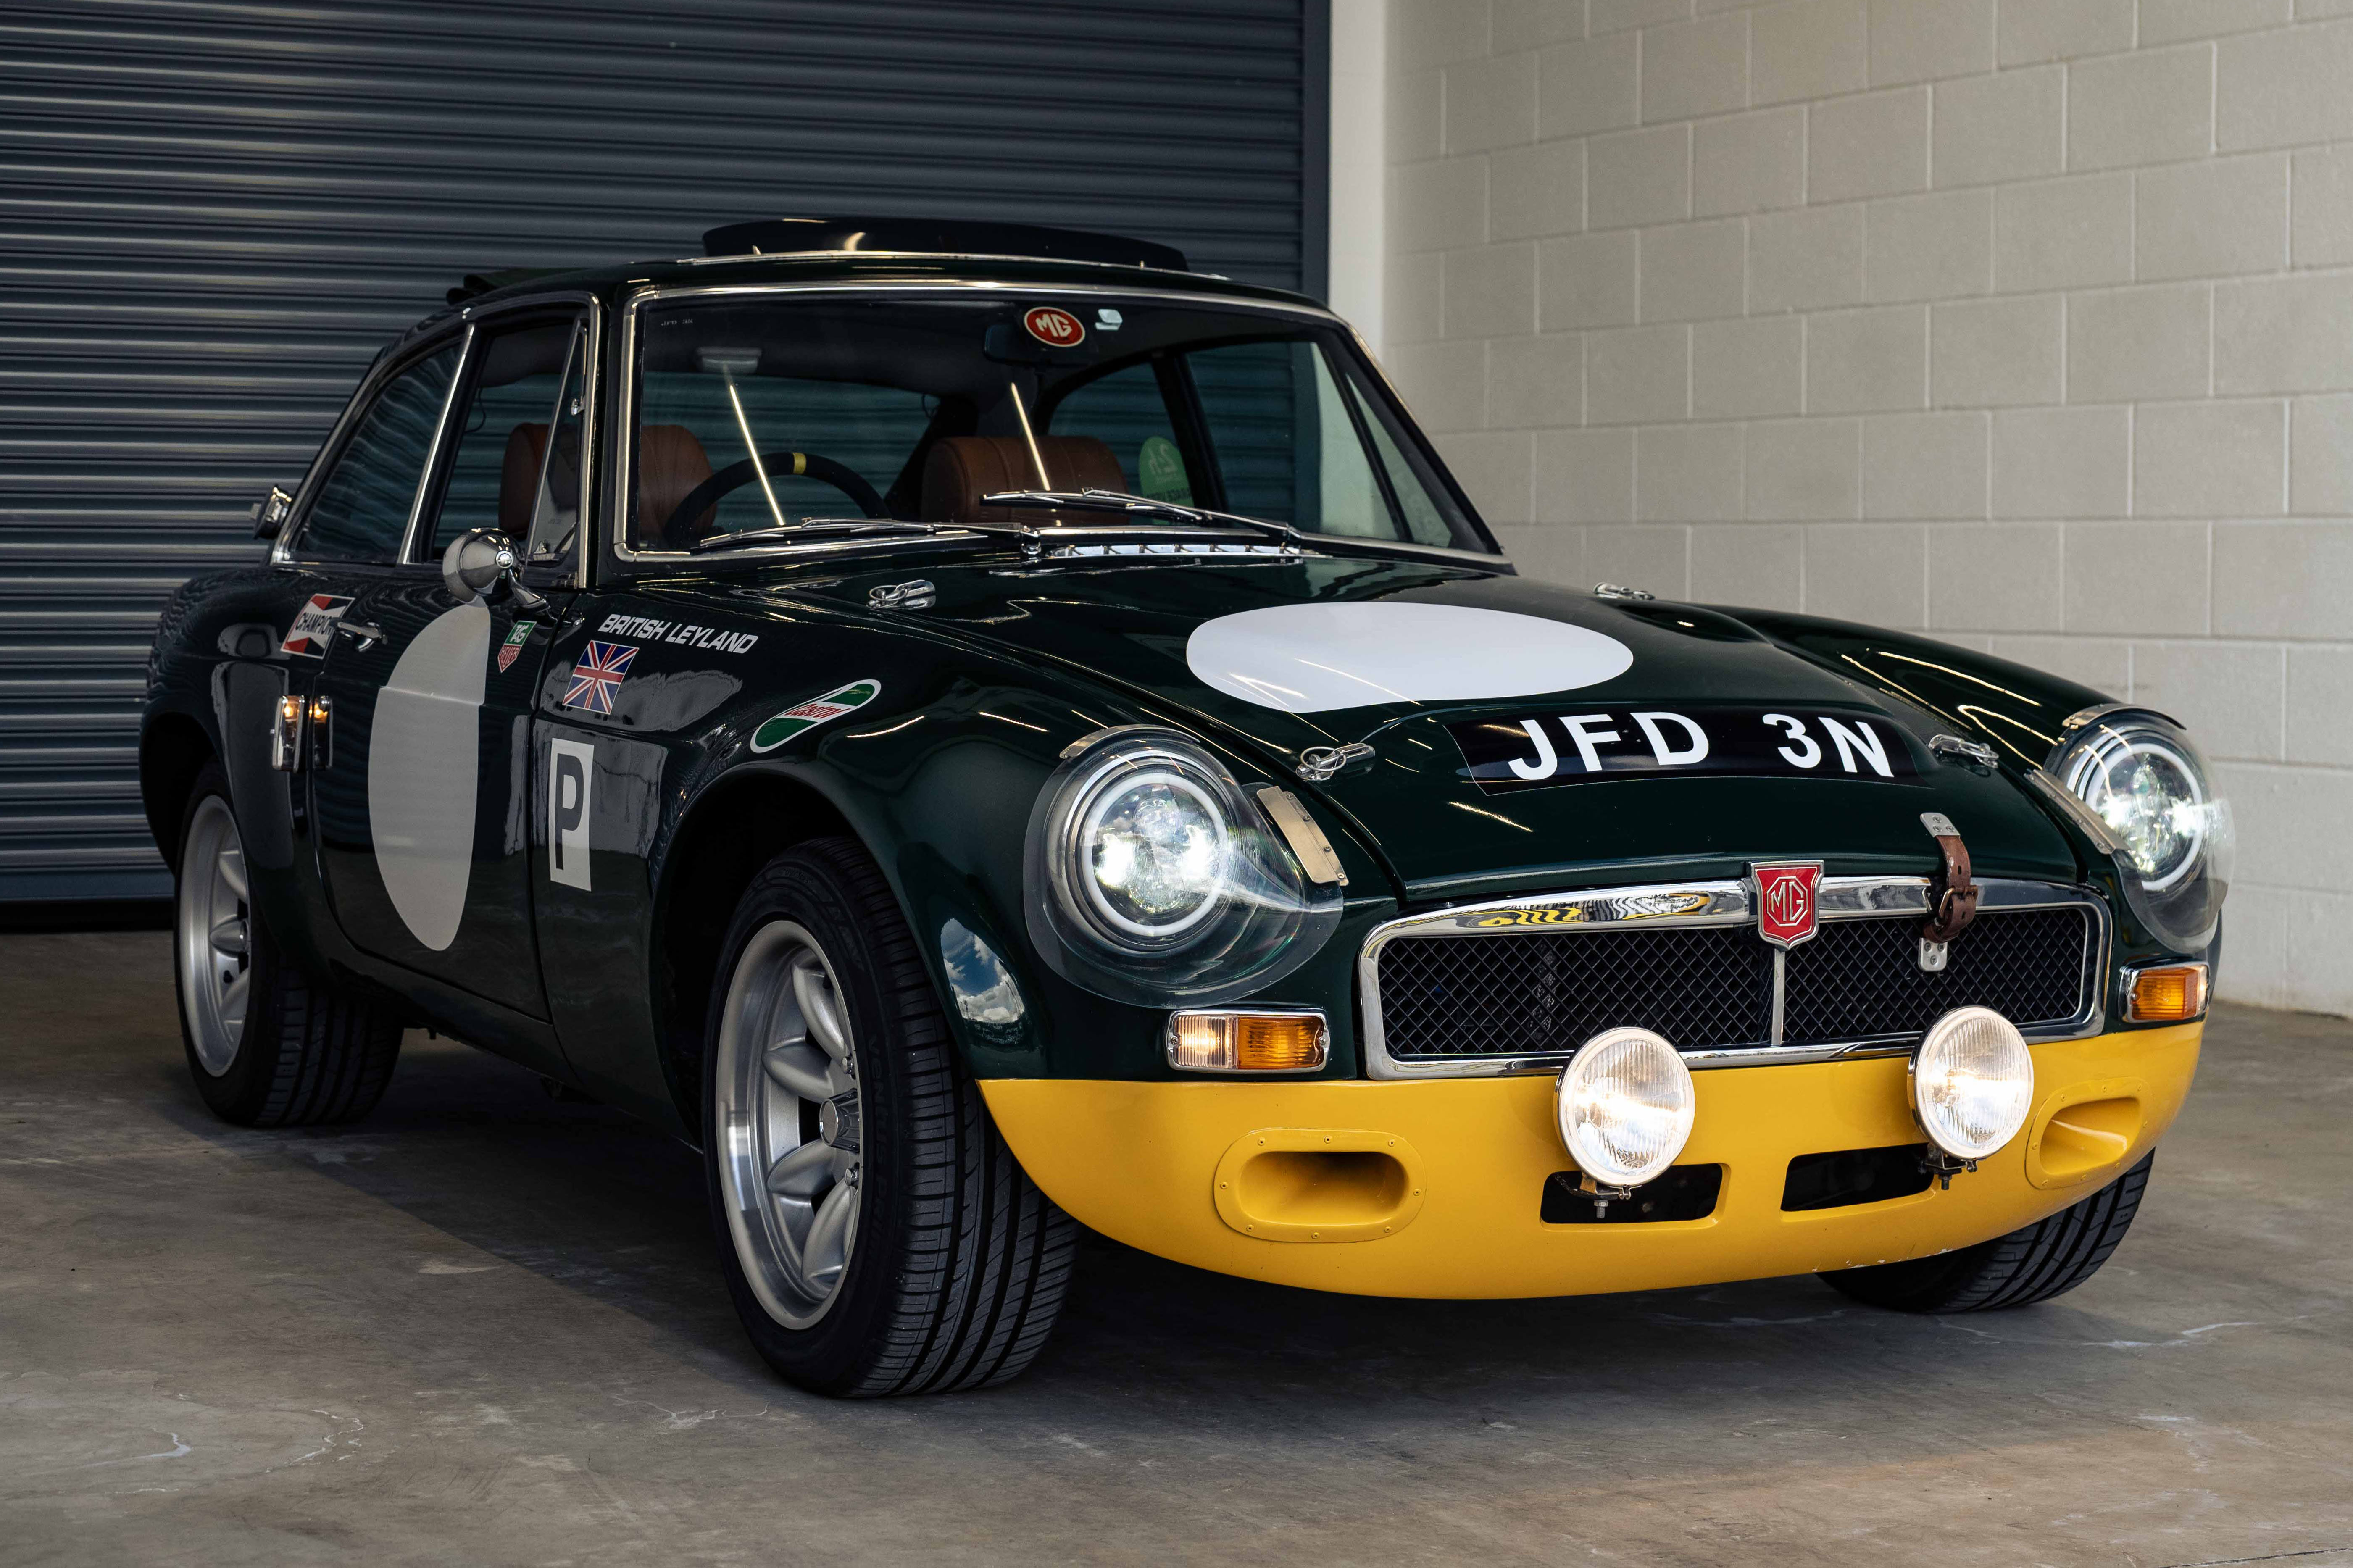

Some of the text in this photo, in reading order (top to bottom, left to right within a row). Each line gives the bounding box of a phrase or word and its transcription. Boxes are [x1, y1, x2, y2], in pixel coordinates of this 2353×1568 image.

[1035, 313, 1073, 337] MG
[509, 624, 529, 643] TAG
[598, 614, 758, 654] BRITISH LEYLAND
[500, 646, 519, 668] HEUER
[784, 703, 851, 719] Castrol
[1508, 712, 1894, 780] JFD 3N
[555, 753, 584, 870] P
[1771, 881, 1804, 921] MG
